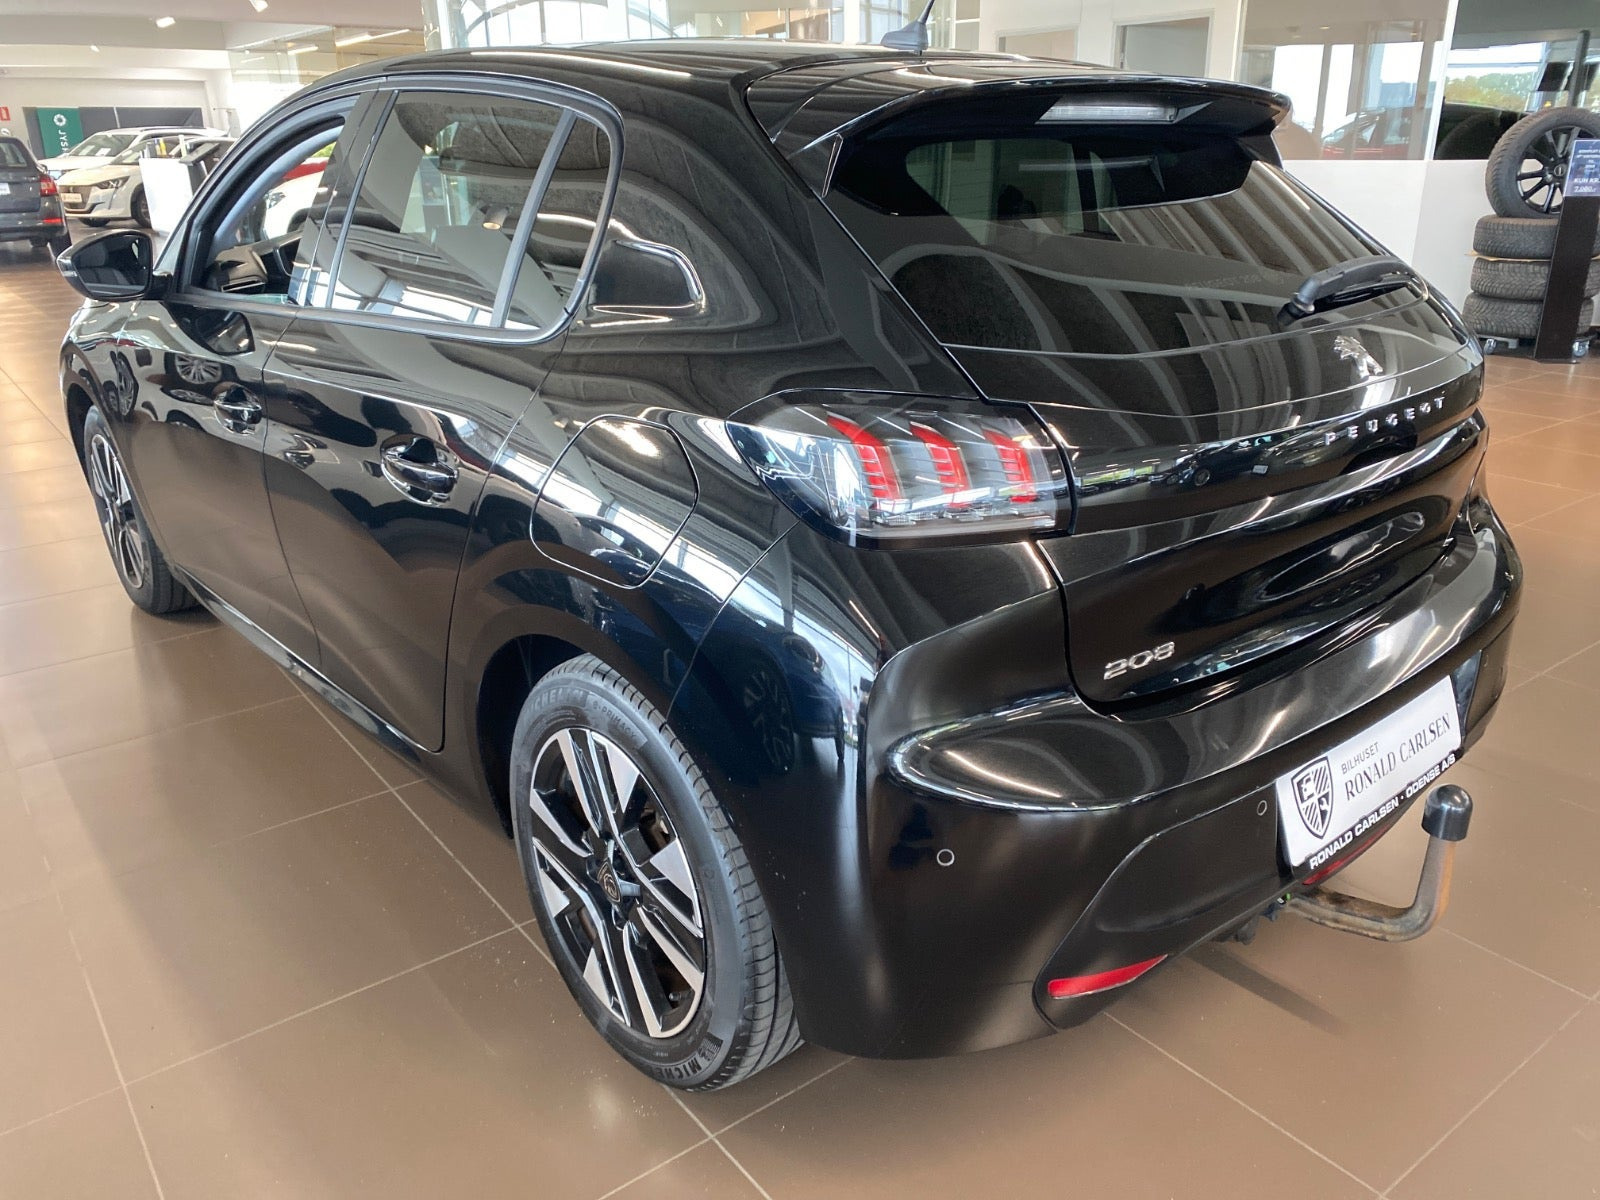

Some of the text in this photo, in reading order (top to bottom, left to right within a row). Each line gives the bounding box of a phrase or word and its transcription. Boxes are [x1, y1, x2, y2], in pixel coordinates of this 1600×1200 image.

[1324, 396, 1445, 446] PEUGEOT
[1103, 641, 1175, 680] 208
[1341, 742, 1379, 775] BILHUSET
[1345, 712, 1451, 801] RONALD CARLSEN
[1309, 754, 1456, 870] RONALD CARLSEN ODENSE A/S
